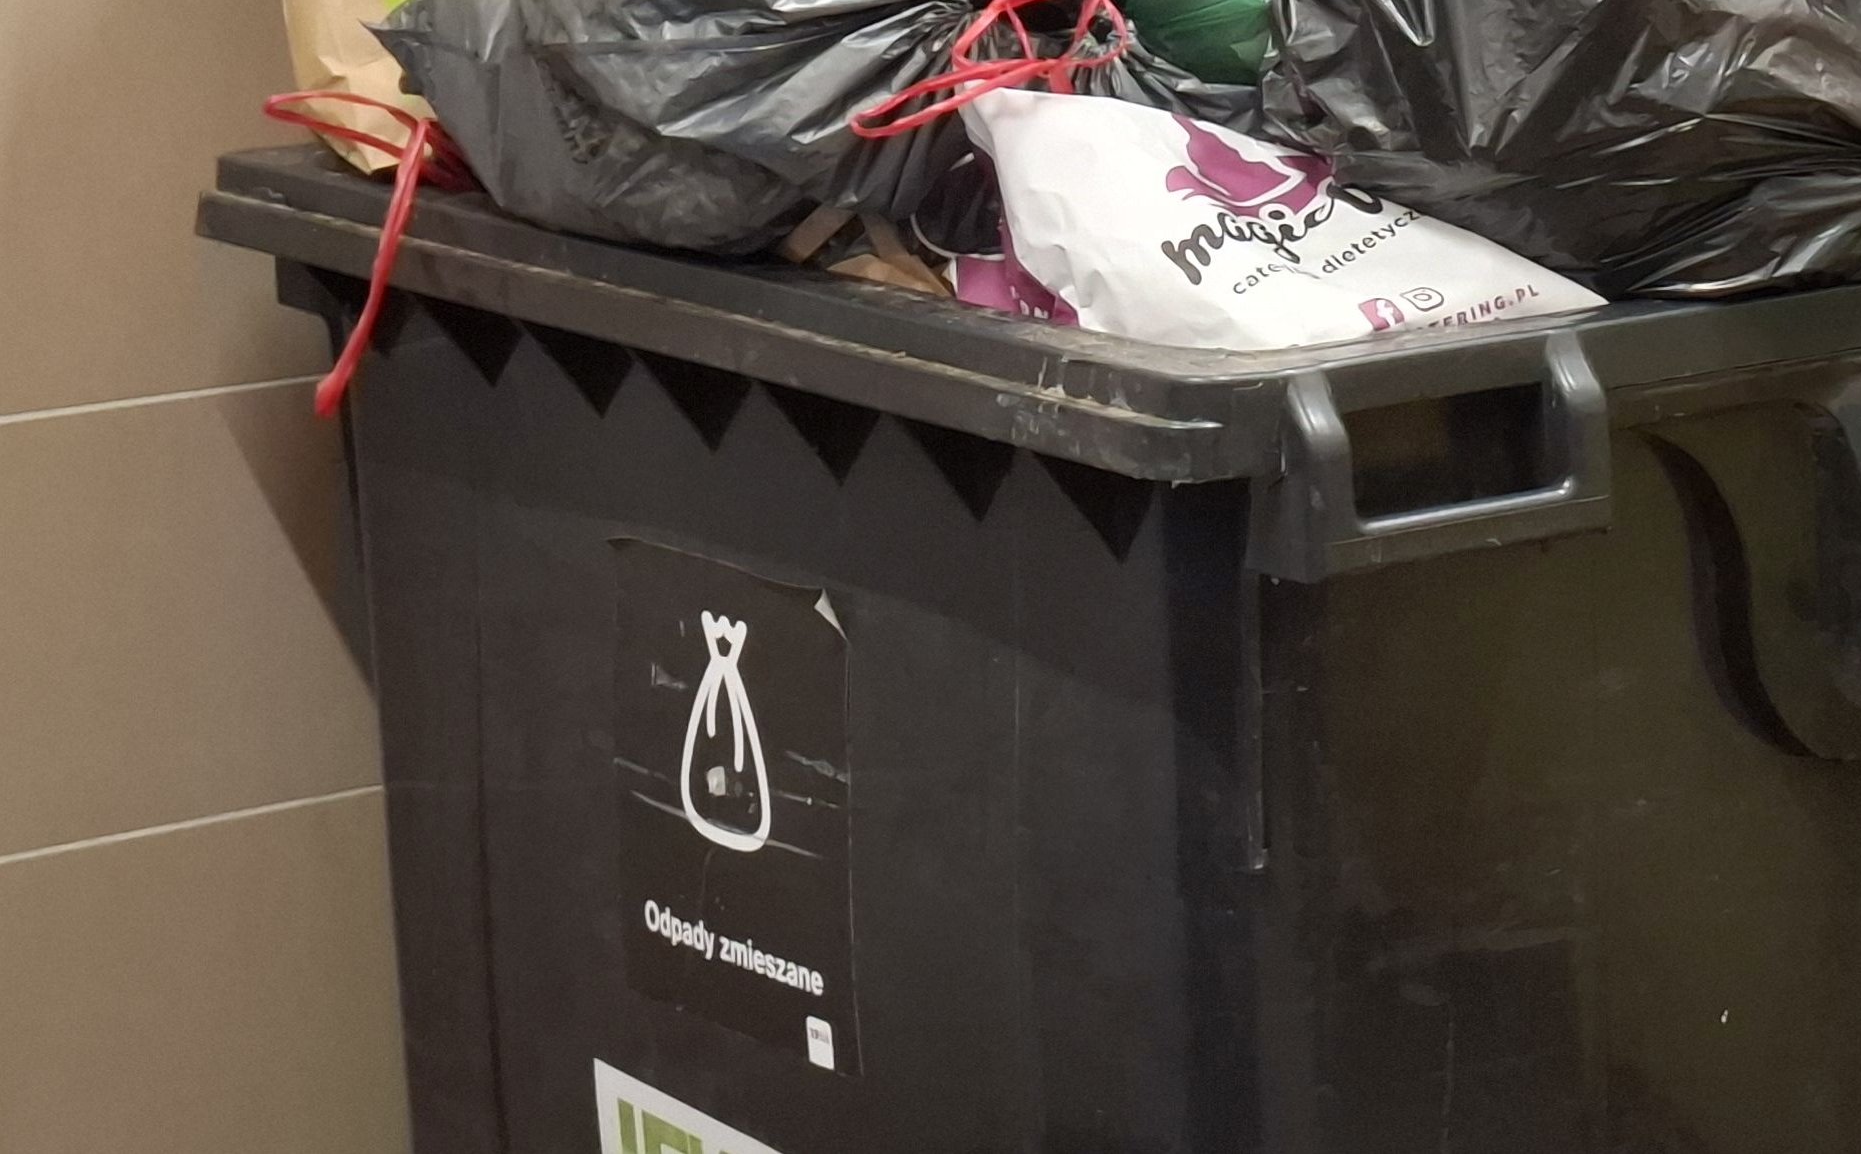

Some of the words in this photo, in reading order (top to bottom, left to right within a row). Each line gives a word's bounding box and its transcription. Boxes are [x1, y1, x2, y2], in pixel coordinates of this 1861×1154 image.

[1233, 262, 1290, 295] cate
[1321, 210, 1421, 275] dietetycz
[1428, 284, 1540, 329] ERING.PL
[643, 899, 715, 960] Odpady
[718, 937, 825, 996] zmieszane
